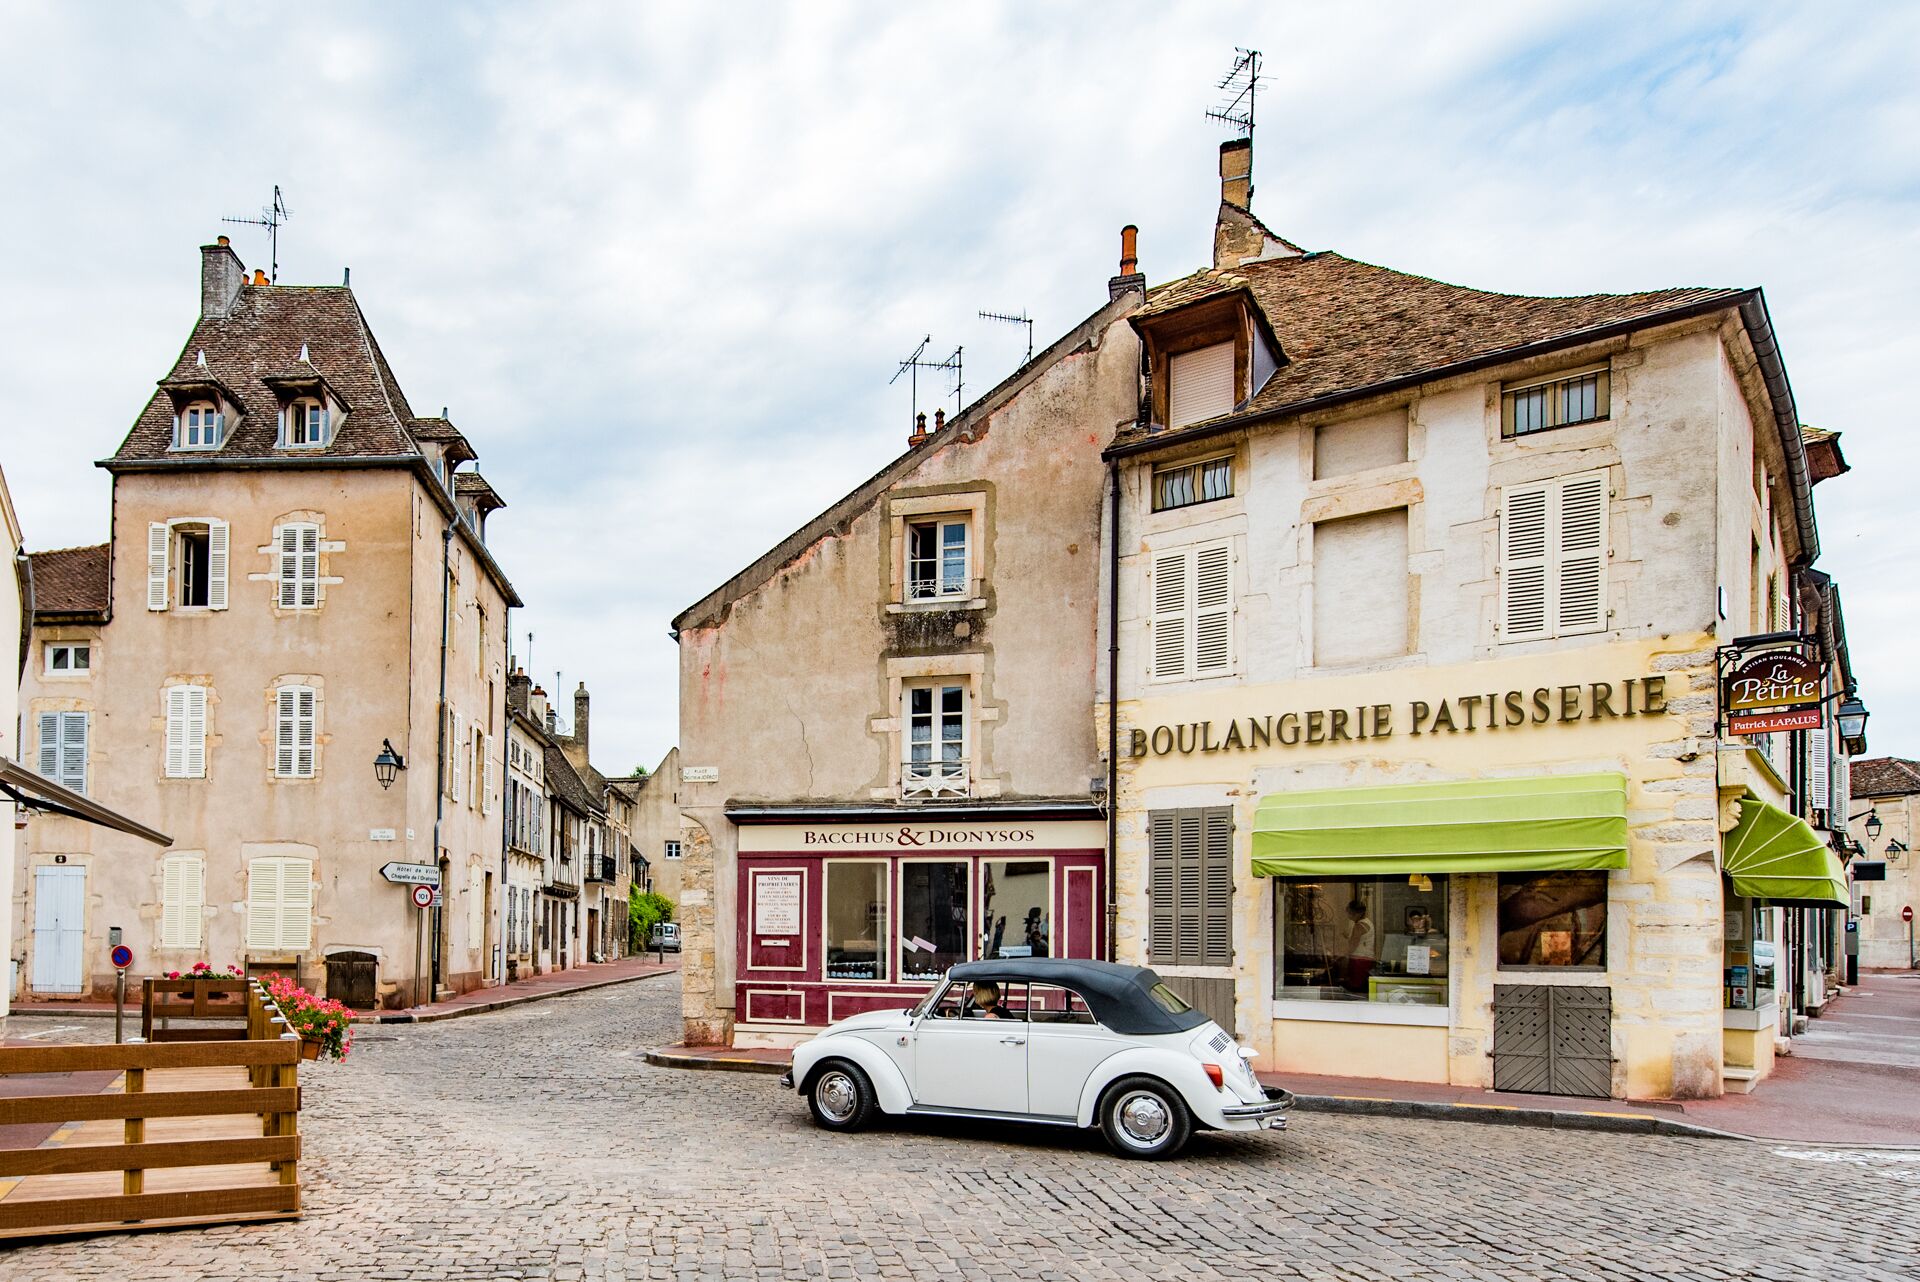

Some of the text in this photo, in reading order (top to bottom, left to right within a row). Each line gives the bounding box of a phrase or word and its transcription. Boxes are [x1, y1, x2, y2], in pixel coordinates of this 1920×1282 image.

[1742, 655, 1807, 674] ARTISAN BOULANGER
[1766, 664, 1795, 683] La
[1731, 677, 1815, 704] Pétrie
[1128, 675, 1669, 758] BOULANGERIE PATISSERIE
[1734, 715, 1818, 730] Patrick LAPALUS
[804, 827, 1035, 846] BACCHUS & DIONYSOS
[1847, 923, 1855, 931] P
